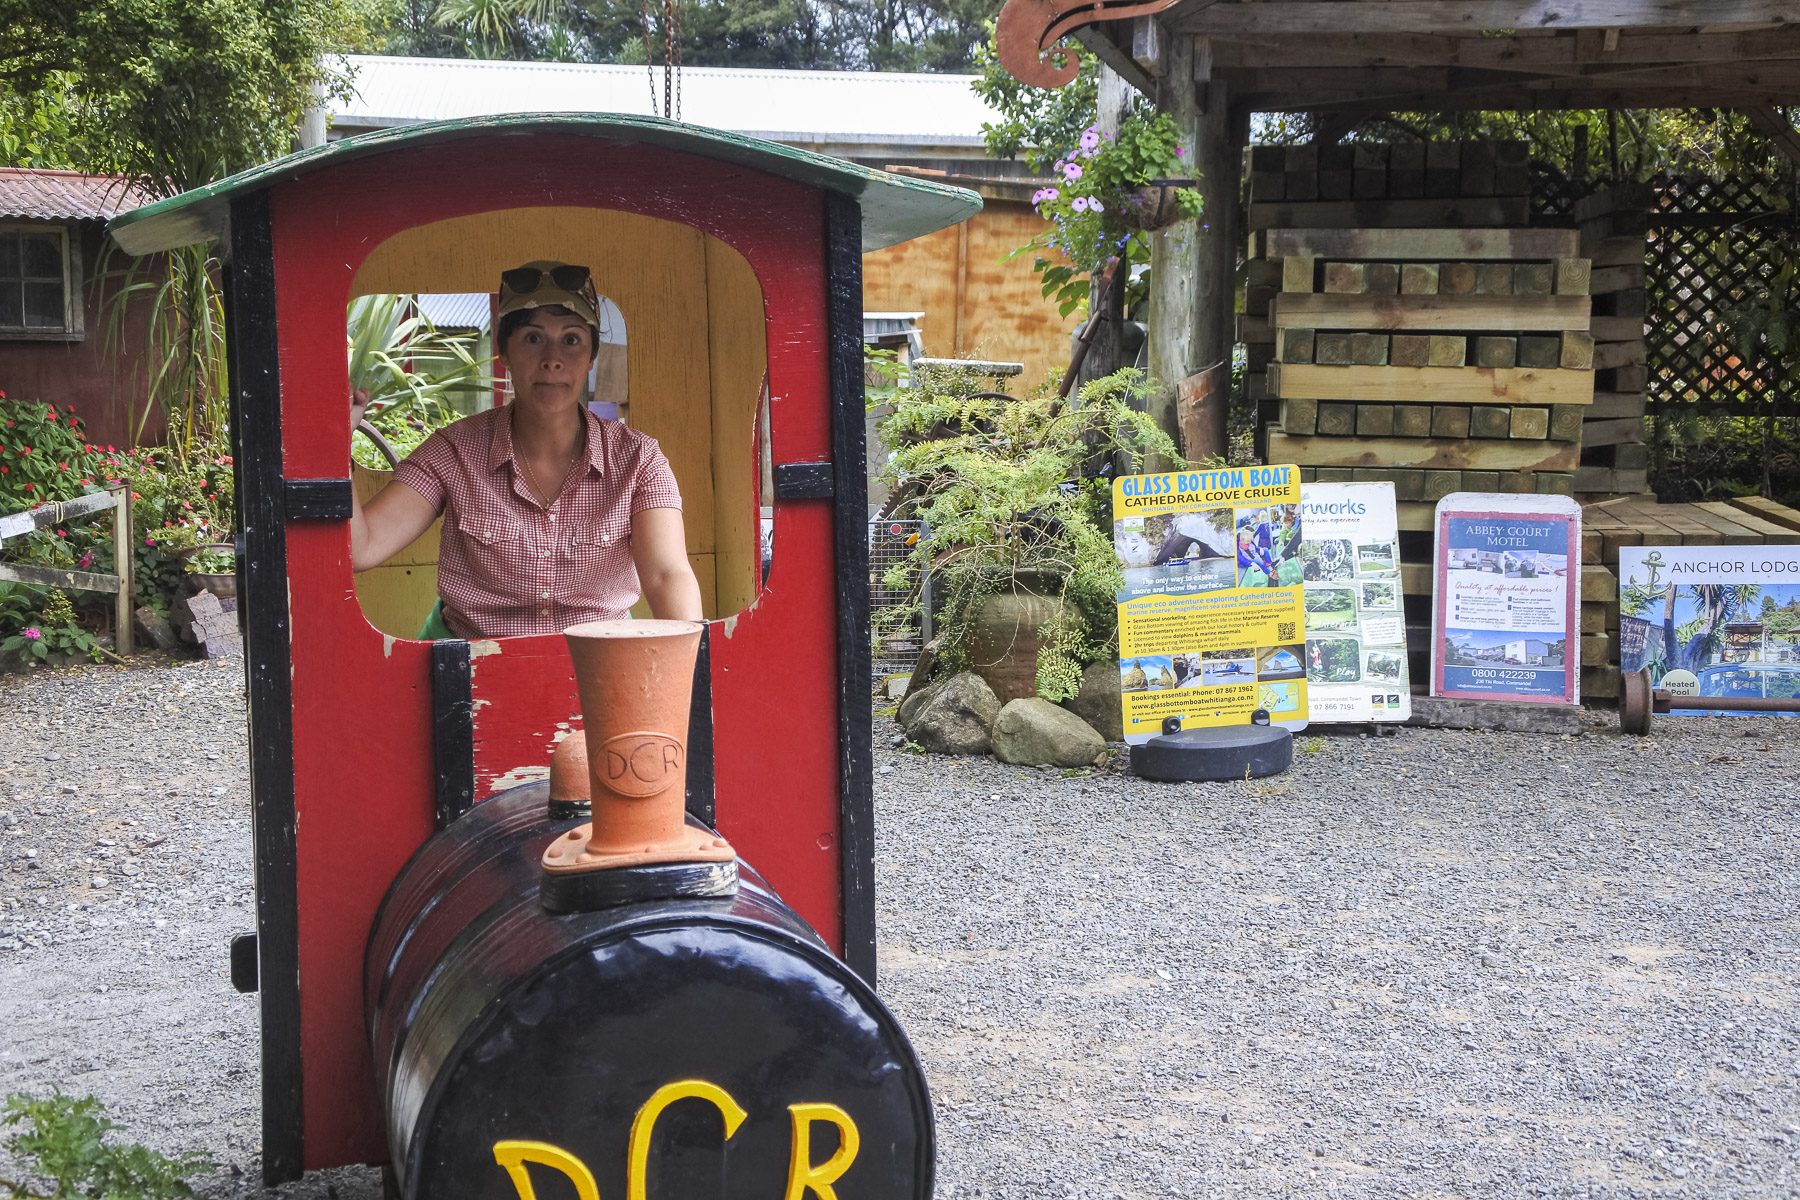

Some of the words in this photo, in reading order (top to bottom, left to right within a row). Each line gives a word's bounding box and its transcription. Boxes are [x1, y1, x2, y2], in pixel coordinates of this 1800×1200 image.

[1122, 475, 1171, 497] GLASS
[1177, 470, 1244, 493] BOTTOM
[1250, 467, 1290, 487] BOAT
[1125, 493, 1202, 507] CATHEDRAL
[1205, 490, 1240, 501] COVE
[1244, 487, 1290, 498] CRUISE
[1302, 498, 1366, 514] rworks
[1465, 525, 1505, 535] ABBEY
[1507, 526, 1551, 536] COURT
[1486, 537, 1528, 546] MOTEL
[1671, 561, 1745, 573] ANCHOR
[1751, 561, 1799, 573] LODG
[1142, 577, 1154, 585] The
[1155, 577, 1169, 585] only
[1170, 576, 1184, 584] way
[1193, 573, 1218, 581] explore
[1165, 584, 1185, 592] below
[1455, 581, 1482, 593] Quality
[1494, 584, 1529, 595] affordable
[1530, 587, 1552, 595] prices
[1168, 598, 1204, 606] adventure
[1205, 595, 1238, 603] exploring
[1240, 592, 1273, 600] Cathedral
[1174, 605, 1208, 613] magnificent
[1336, 667, 1356, 679] Play
[1471, 669, 1496, 678] 0800
[1499, 670, 1537, 680] 422239
[1131, 694, 1160, 702] Bookings
[1131, 695, 1254, 710] www.glassbottomboatwhitianga.co.nz
[1339, 703, 1355, 711] 7191
[606, 742, 678, 782] DCR
